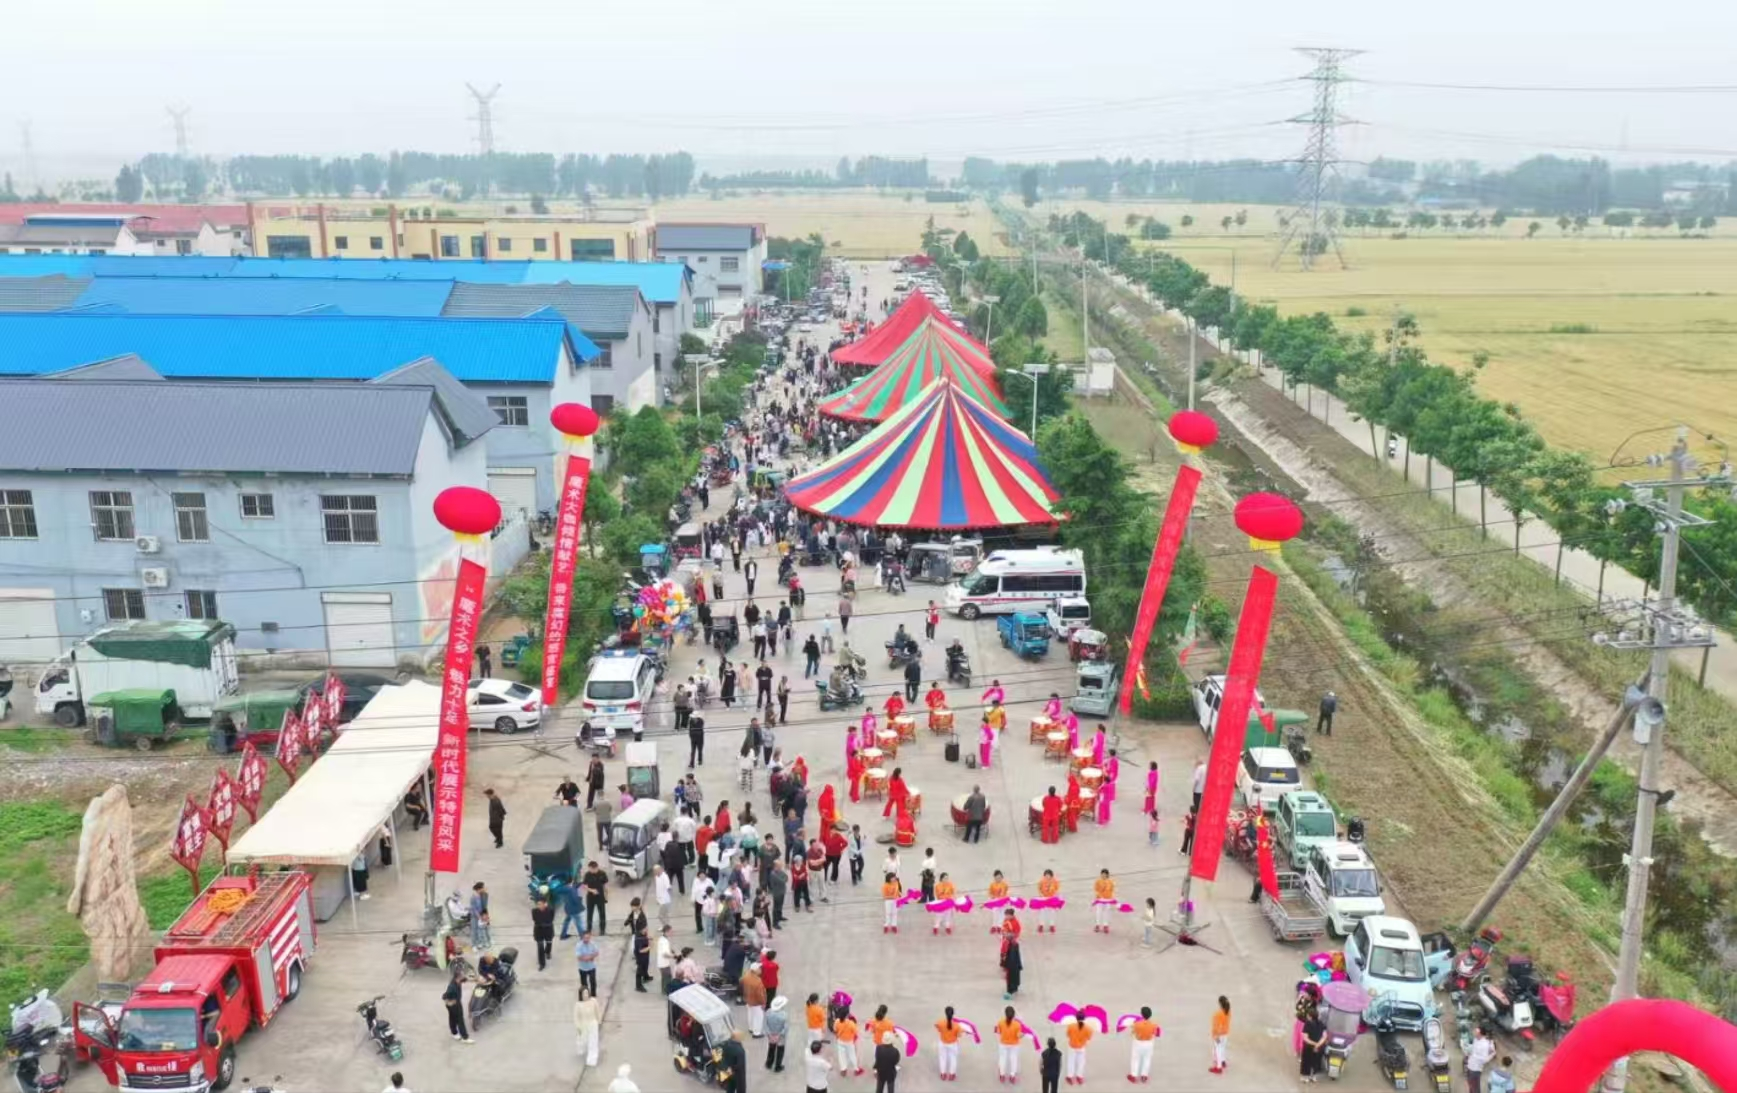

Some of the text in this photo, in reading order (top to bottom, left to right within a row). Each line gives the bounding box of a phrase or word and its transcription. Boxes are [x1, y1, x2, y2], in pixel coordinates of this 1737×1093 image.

[437, 733, 461, 852] 新时代展示特有风采
